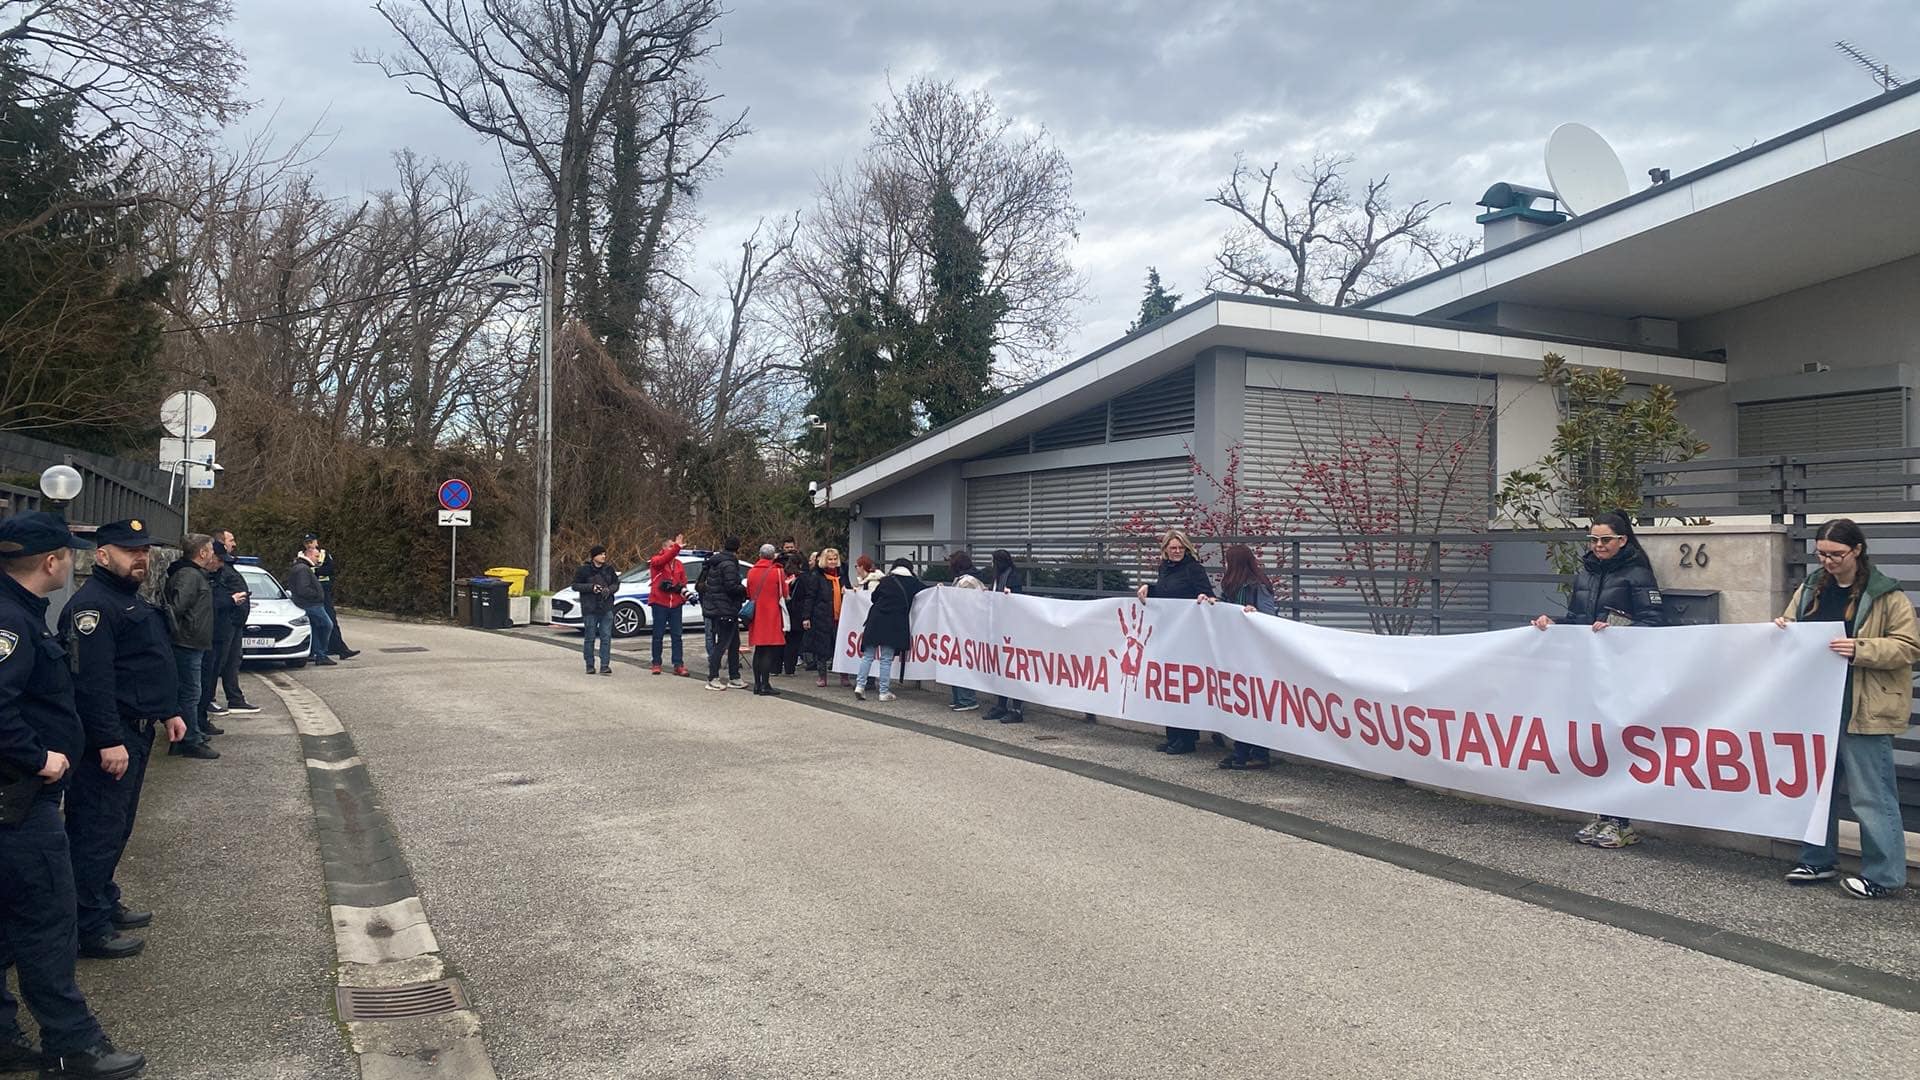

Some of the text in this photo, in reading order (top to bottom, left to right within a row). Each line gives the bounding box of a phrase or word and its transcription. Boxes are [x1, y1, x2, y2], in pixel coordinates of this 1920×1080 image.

[1679, 543, 1709, 569] 26
[938, 635, 963, 668] SA
[963, 639, 1001, 677] SVIM
[1001, 636, 1110, 694] ŽRTVAMA
[1144, 660, 1352, 739] REPRESIVNOG
[1353, 697, 1561, 775] SUSTAVA
[1568, 720, 1610, 779] U
[1621, 725, 1828, 800] SRBIJI
